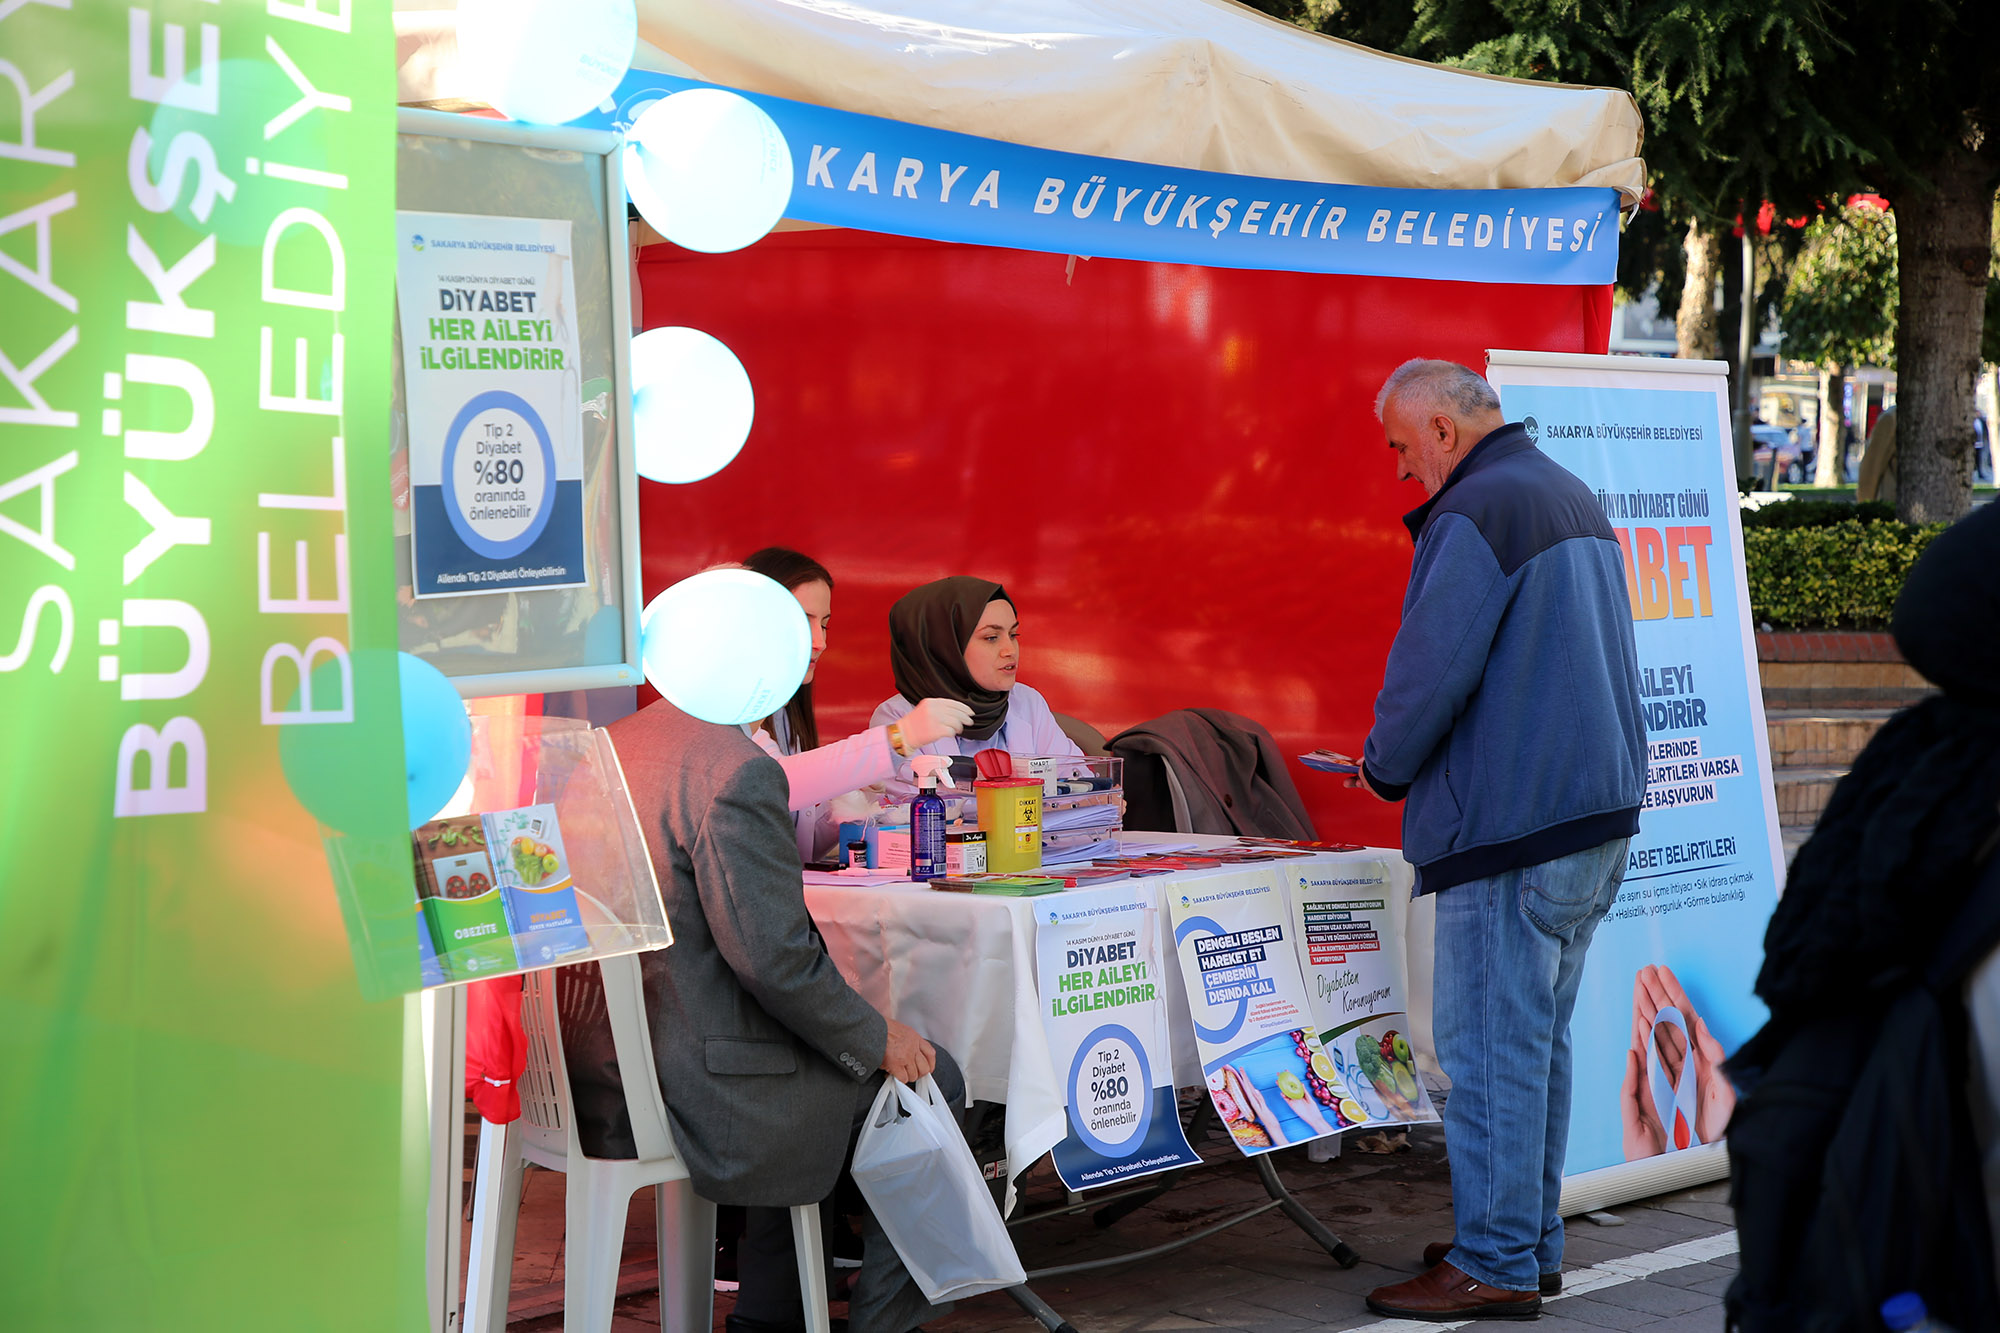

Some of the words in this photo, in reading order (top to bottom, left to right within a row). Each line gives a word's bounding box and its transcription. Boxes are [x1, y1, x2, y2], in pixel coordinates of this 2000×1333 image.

[1033, 175, 1347, 240] BÜYÜKŞEHİR
[1366, 208, 1603, 252] BELEDİYESİ
[431, 240, 466, 248] SAKARYA
[468, 240, 513, 251] BÜYÜKŞEHİR
[515, 243, 555, 253] BELEDİYESİ
[429, 318, 476, 341] HER
[484, 424, 503, 439] Tip
[506, 424, 513, 436] 2
[1547, 425, 1594, 439] SAKARYA
[1596, 423, 1652, 442] BÜYÜKŞEHİR
[1653, 424, 1703, 441] BELEDİYESİ
[476, 441, 521, 457] Diyabet
[474, 459, 524, 485] %80
[475, 488, 526, 503] oranında
[1629, 488, 1675, 519] DİYABET
[1678, 488, 1709, 518] GÜNÜ
[469, 506, 531, 520] önlenebilir
[467, 571, 480, 583] Tip
[480, 571, 487, 581] 2
[1700, 758, 1740, 777] VARSA
[1655, 784, 1714, 808] BAŞVURUN
[1666, 836, 1737, 865] BELİRTİLERİ
[1617, 893, 1626, 902] ve
[1643, 889, 1652, 899] su
[1653, 885, 1670, 898] içme
[1671, 880, 1693, 895] ihtiyacı
[1709, 876, 1728, 889] idrara
[1729, 871, 1754, 886] çıkmak
[1193, 895, 1215, 904] SAKARYA
[1650, 902, 1683, 916] yorgunluk
[1711, 888, 1746, 905] bulanıklığı
[1062, 910, 1087, 921] SAKARYA
[1088, 904, 1119, 917] BÜYÜKŞEHİR
[1120, 901, 1147, 912] BELEDİYESİ
[454, 923, 498, 940] OBEZİTE
[1072, 937, 1087, 945] KASIM
[1088, 934, 1104, 943] DÜNYA
[1104, 931, 1123, 941] DİYABET
[1123, 929, 1136, 937] GÜNÜ
[1197, 933, 1240, 953] DENGELİ
[1241, 927, 1280, 943] BESLEN
[1201, 951, 1248, 970] HAREKET
[1249, 948, 1262, 961] ET
[1059, 971, 1093, 992] HER
[1205, 965, 1257, 988] ÇEMBERİN
[1317, 969, 1360, 1003] Diyabetten
[1208, 984, 1250, 1003] DIŞINDA
[1251, 980, 1273, 996] KAL
[1098, 1051, 1112, 1063] Tip
[1114, 1049, 1120, 1060] 2
[1092, 1062, 1126, 1078] Diyabet
[1091, 1076, 1129, 1102] %80
[1093, 1099, 1131, 1116] oranında
[1091, 1112, 1137, 1131] önlenebilir
[1081, 1170, 1104, 1181] Ailende
[1103, 1168, 1114, 1177] Tip
